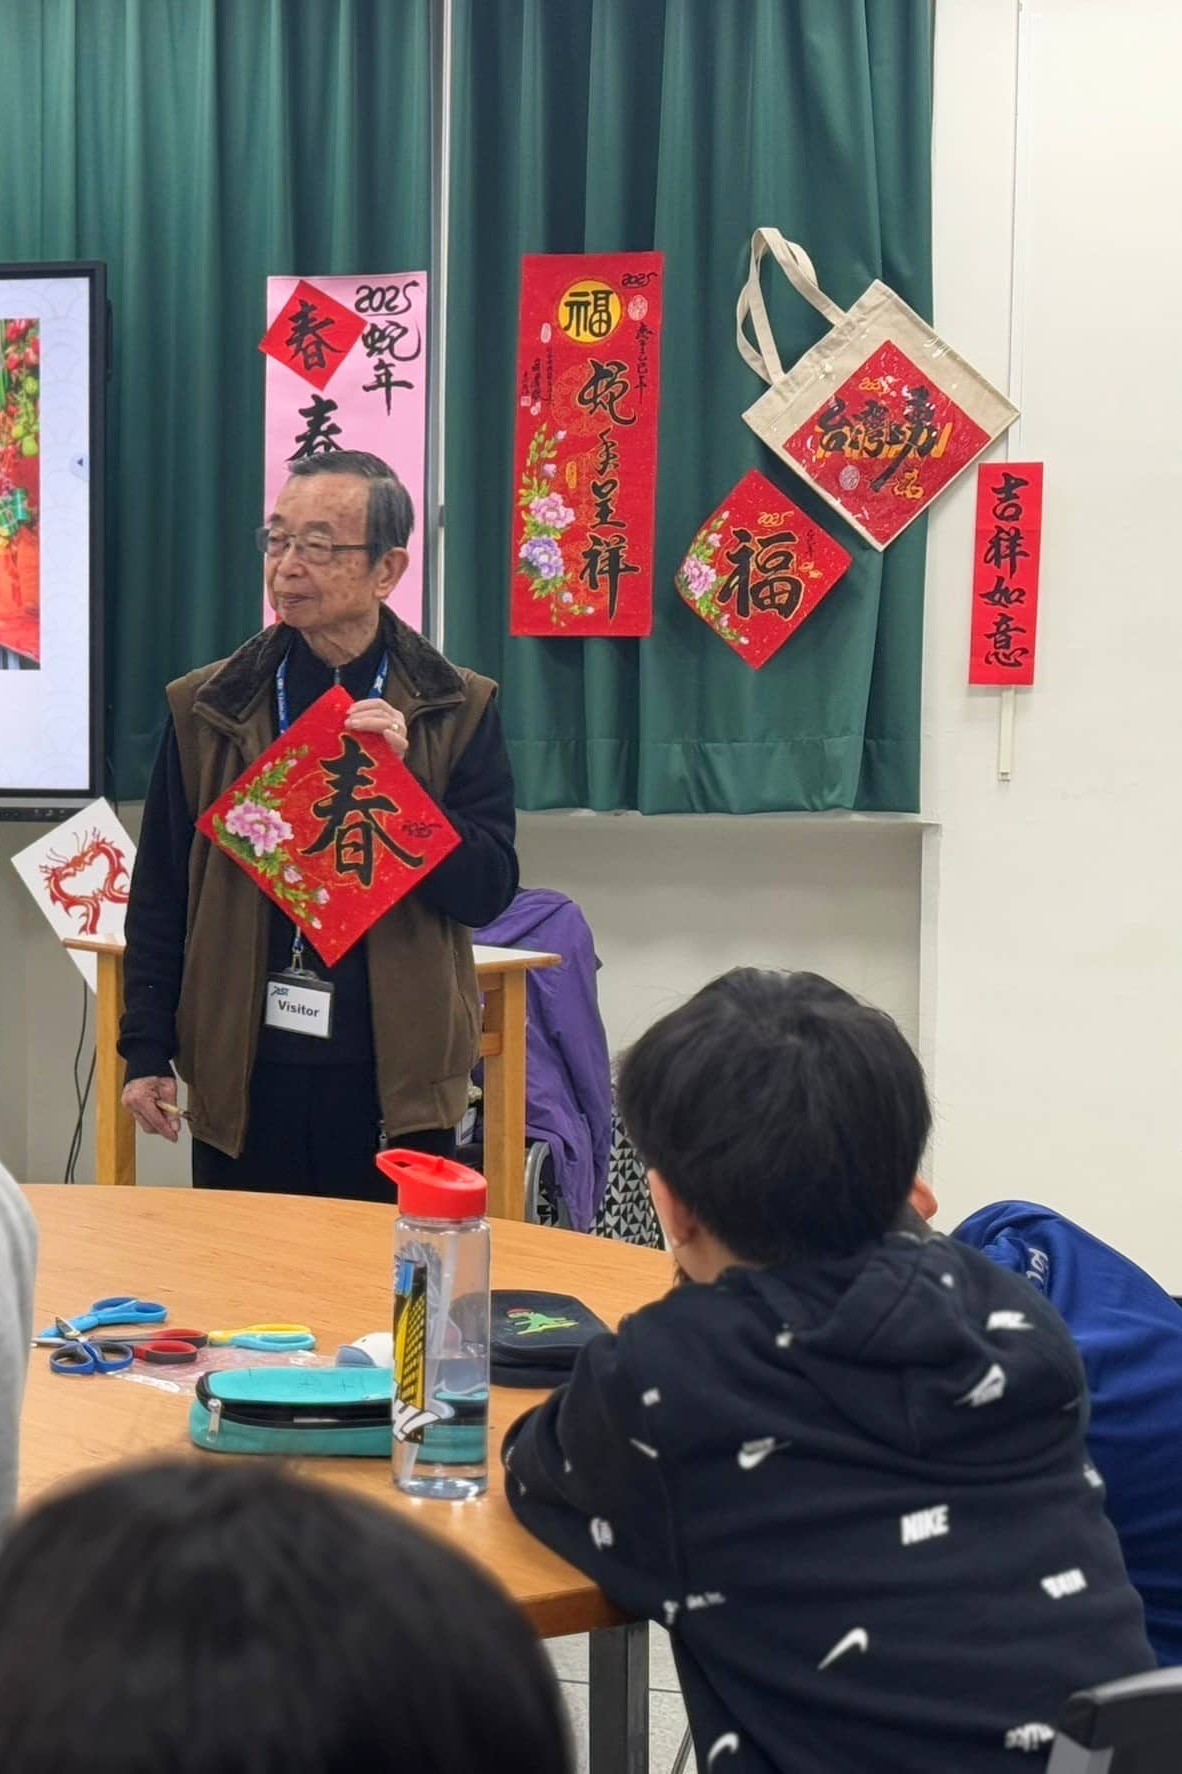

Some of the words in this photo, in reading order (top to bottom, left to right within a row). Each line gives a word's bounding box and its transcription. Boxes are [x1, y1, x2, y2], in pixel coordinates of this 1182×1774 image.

[355, 280, 420, 316] 2025
[621, 271, 658, 288] 2025
[285, 299, 345, 371] 春
[563, 289, 614, 338] 福
[361, 320, 421, 416] 蛇年
[716, 528, 804, 620] 福
[979, 472, 1031, 668] 吉祥如意
[300, 735, 423, 886] 春
[278, 1000, 320, 1017] Visitor
[901, 1505, 949, 1545] NIKE
